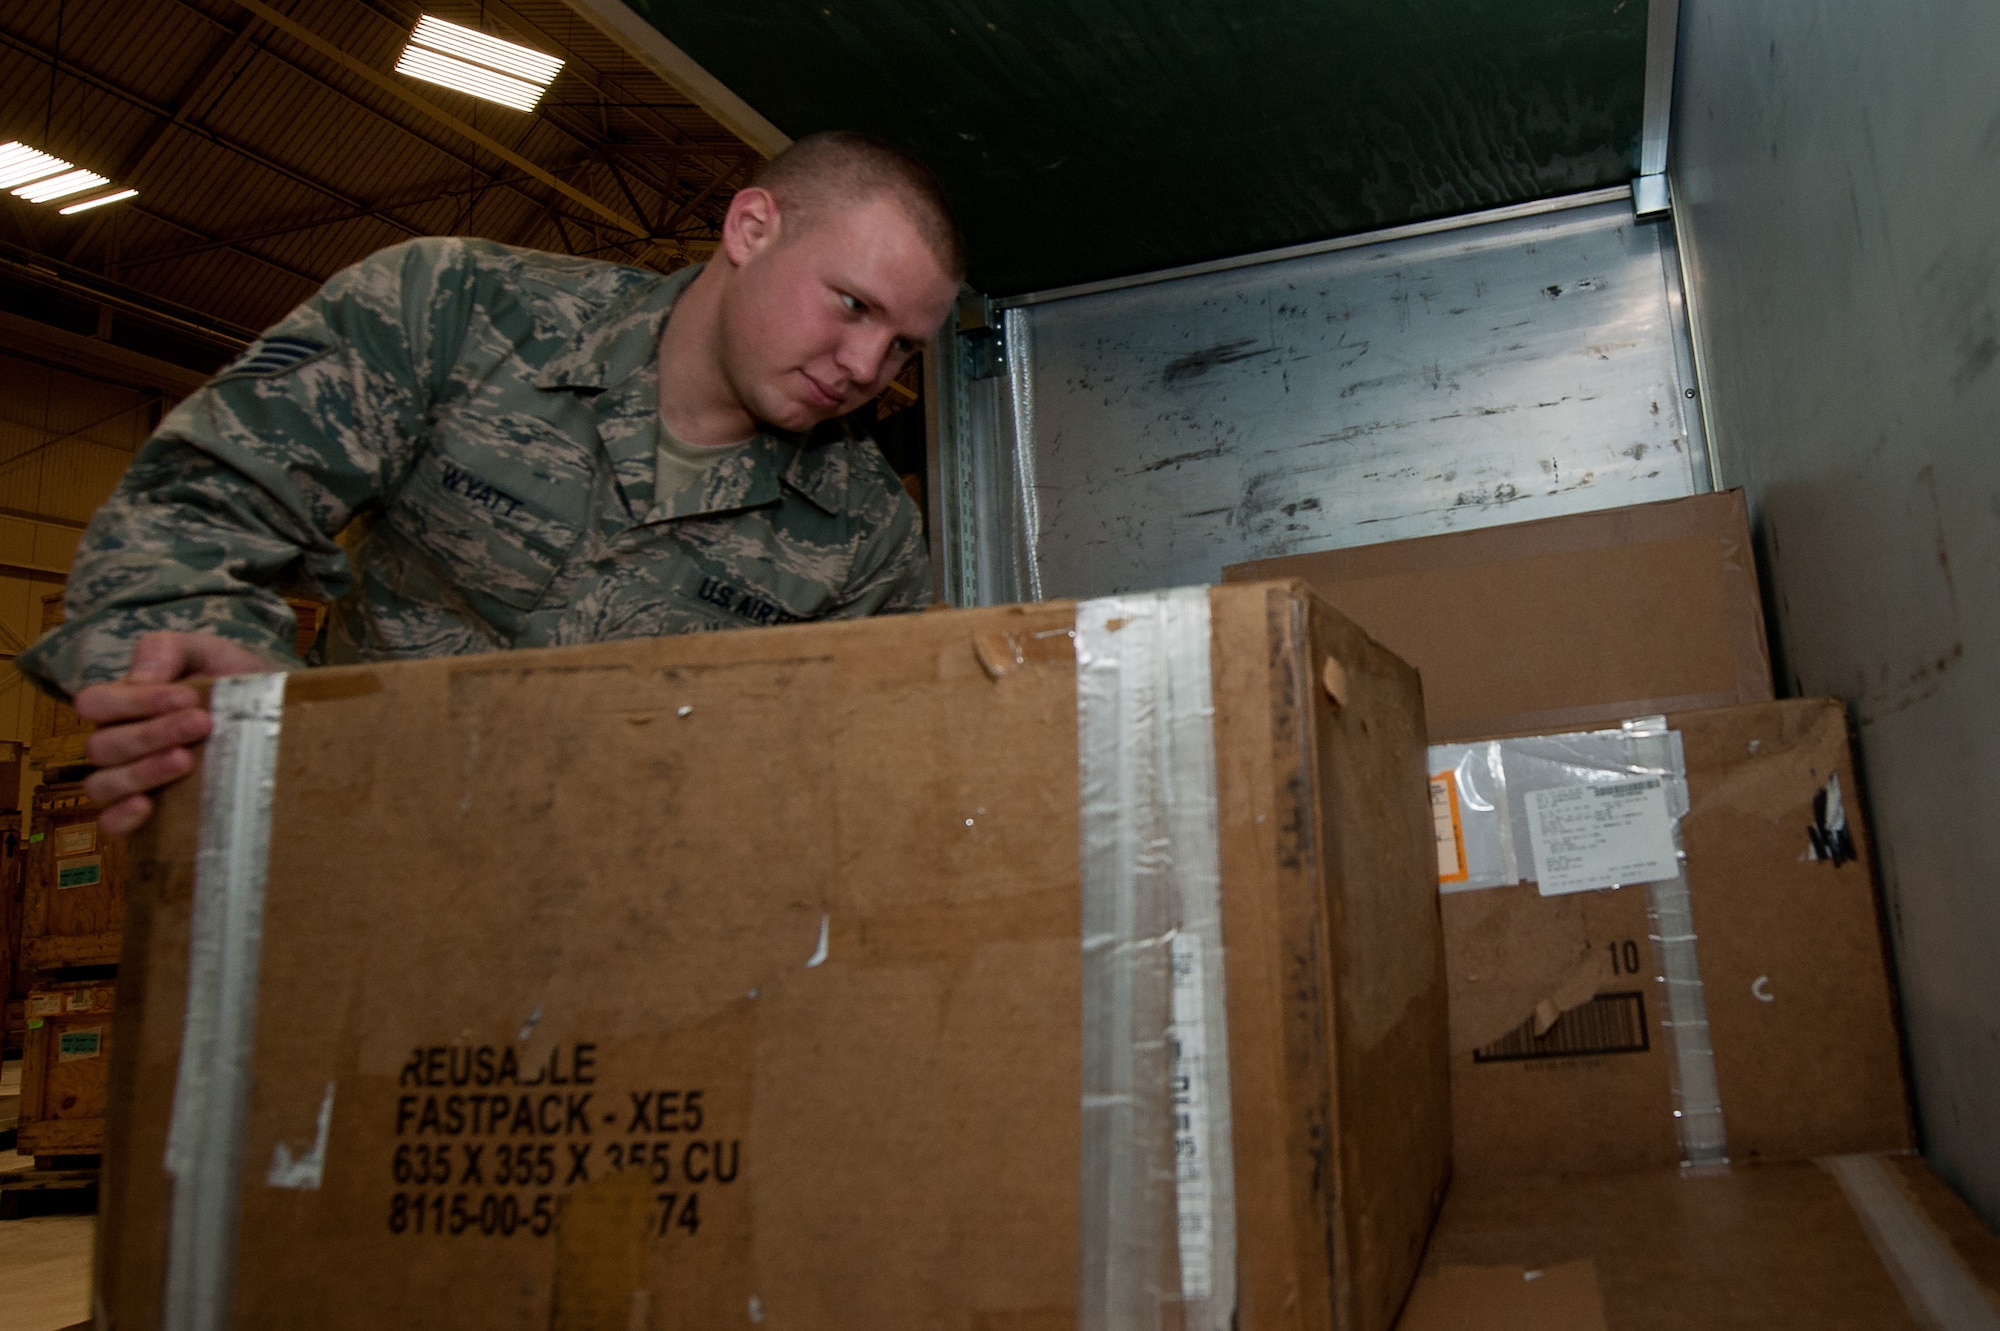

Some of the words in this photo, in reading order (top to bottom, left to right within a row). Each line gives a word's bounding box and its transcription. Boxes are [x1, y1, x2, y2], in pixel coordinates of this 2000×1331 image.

[441, 460, 525, 518] WYATT
[735, 596, 775, 624] AIR
[1608, 939, 1641, 975] 10
[400, 1043, 597, 1086] REUSALE
[395, 1092, 593, 1136] FASTPACK
[627, 1090, 704, 1134] XE5
[392, 1143, 452, 1185] 635
[461, 1144, 483, 1184] X
[496, 1143, 555, 1185] 355
[566, 1142, 592, 1186] X
[682, 1139, 740, 1184] CU
